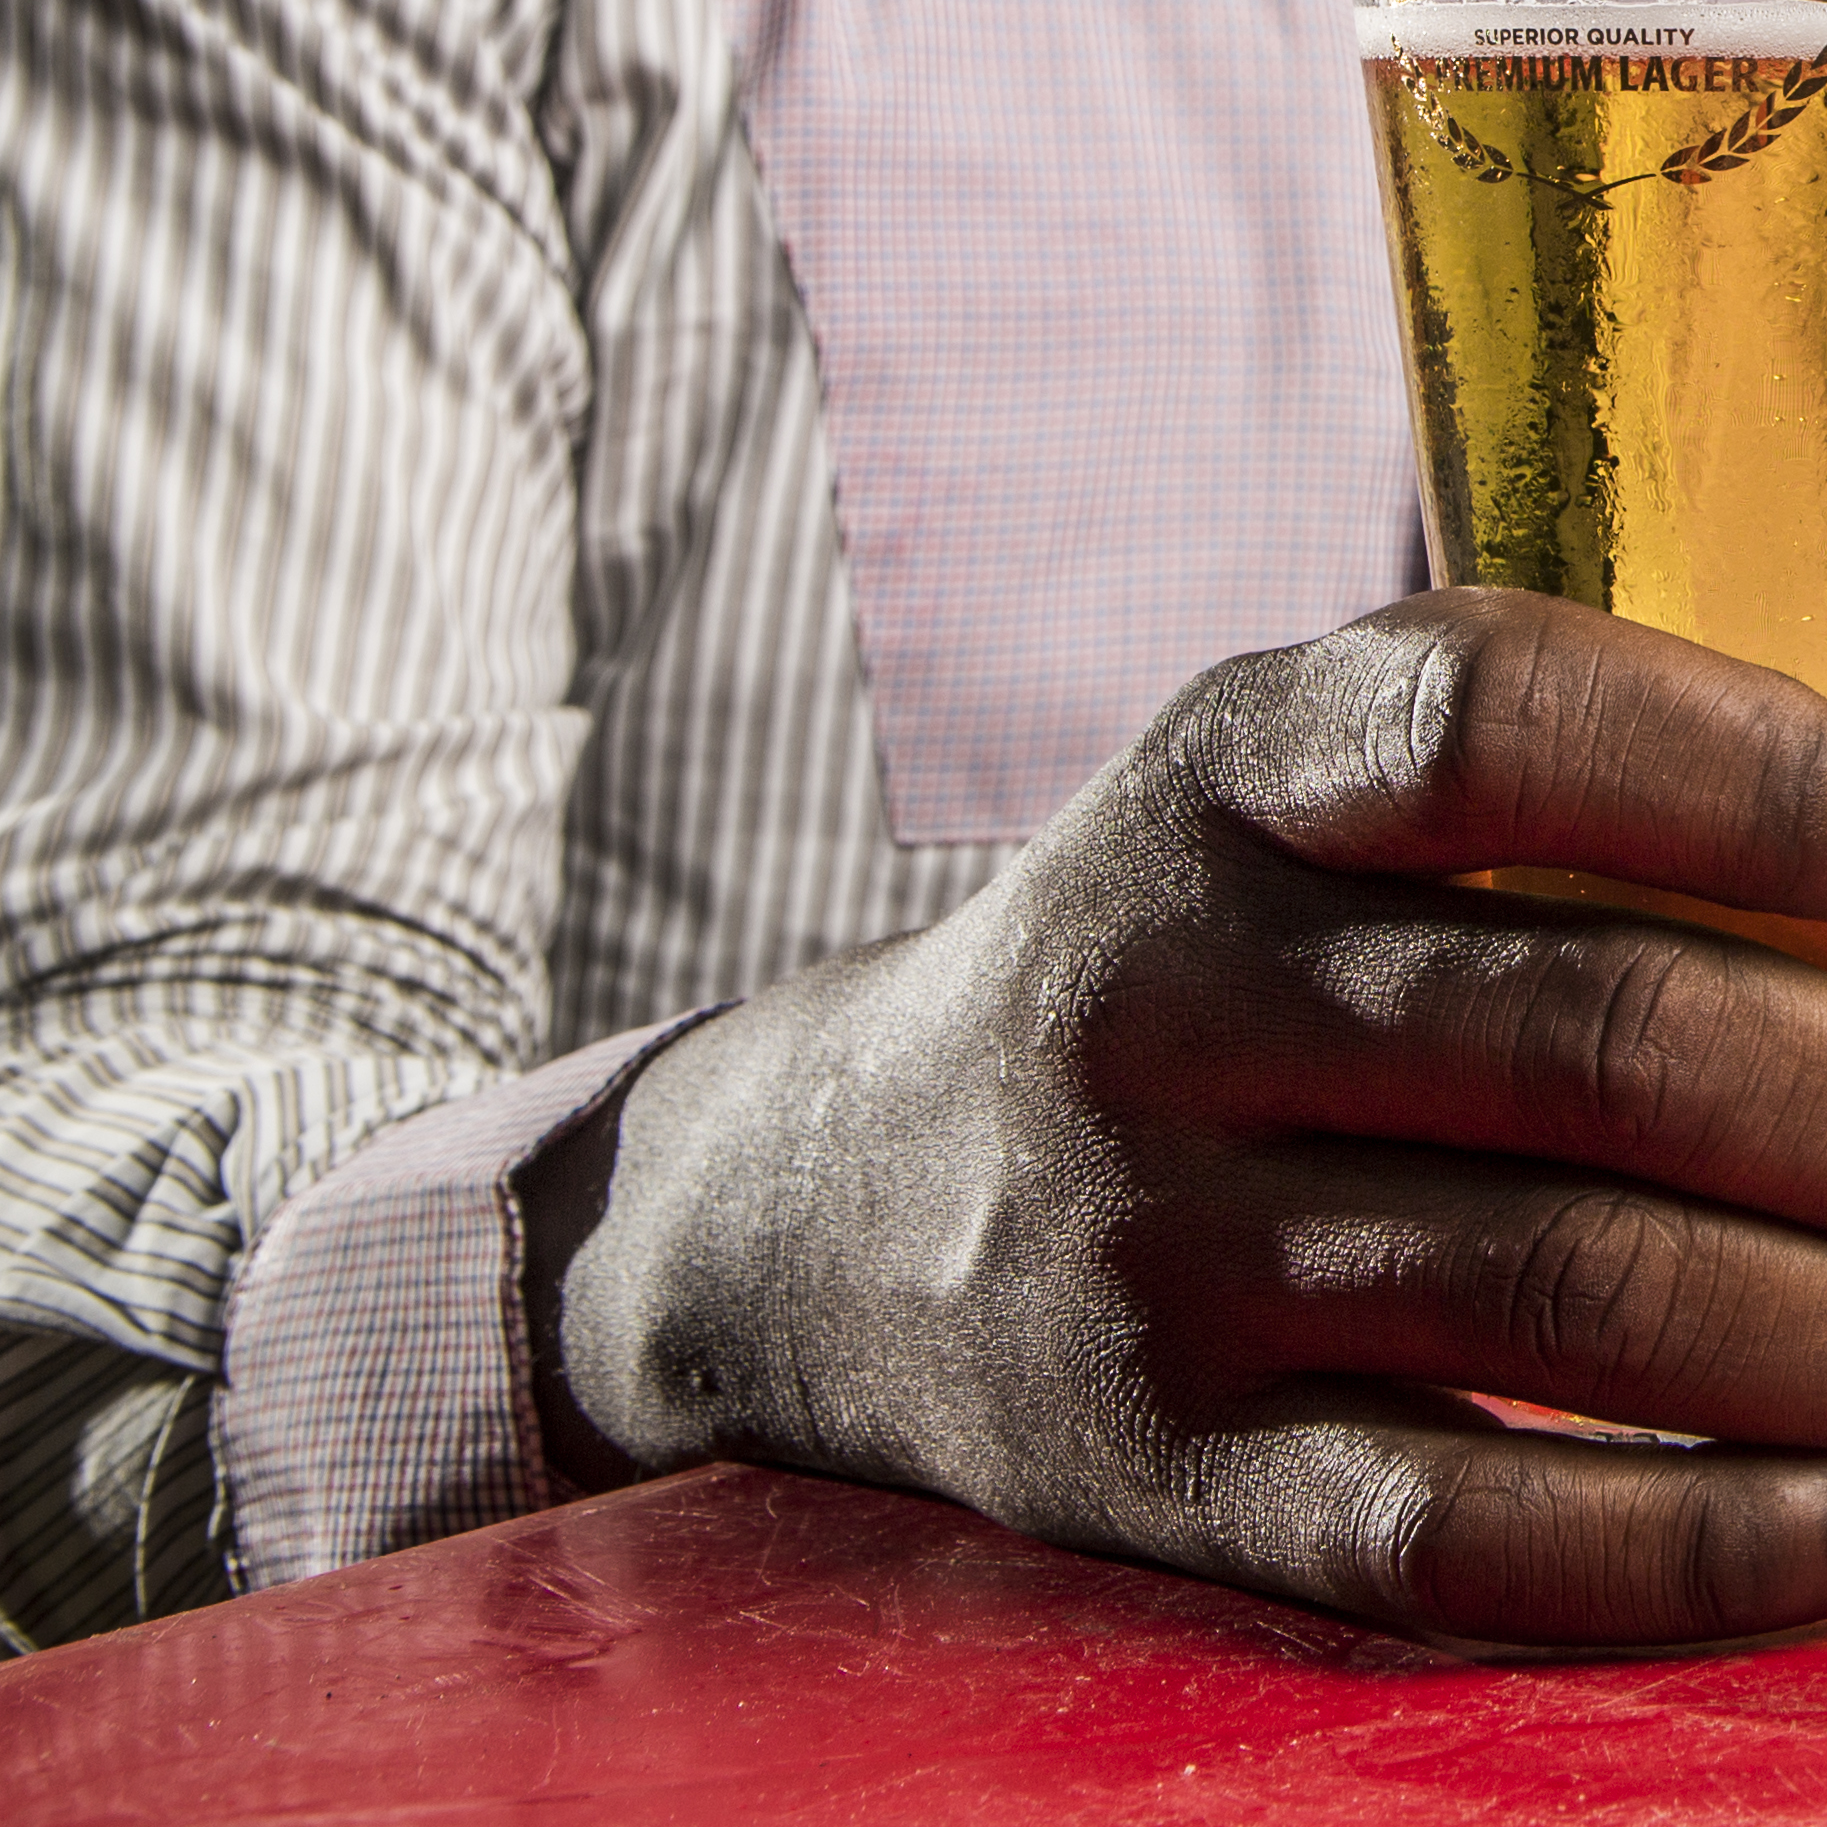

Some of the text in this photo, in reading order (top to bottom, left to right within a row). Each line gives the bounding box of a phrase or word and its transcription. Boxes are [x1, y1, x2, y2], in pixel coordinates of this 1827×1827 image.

[1474, 28, 1696, 47] SUPERIOR QUALITY
[1436, 55, 1760, 92] PREMIUM LAGER
